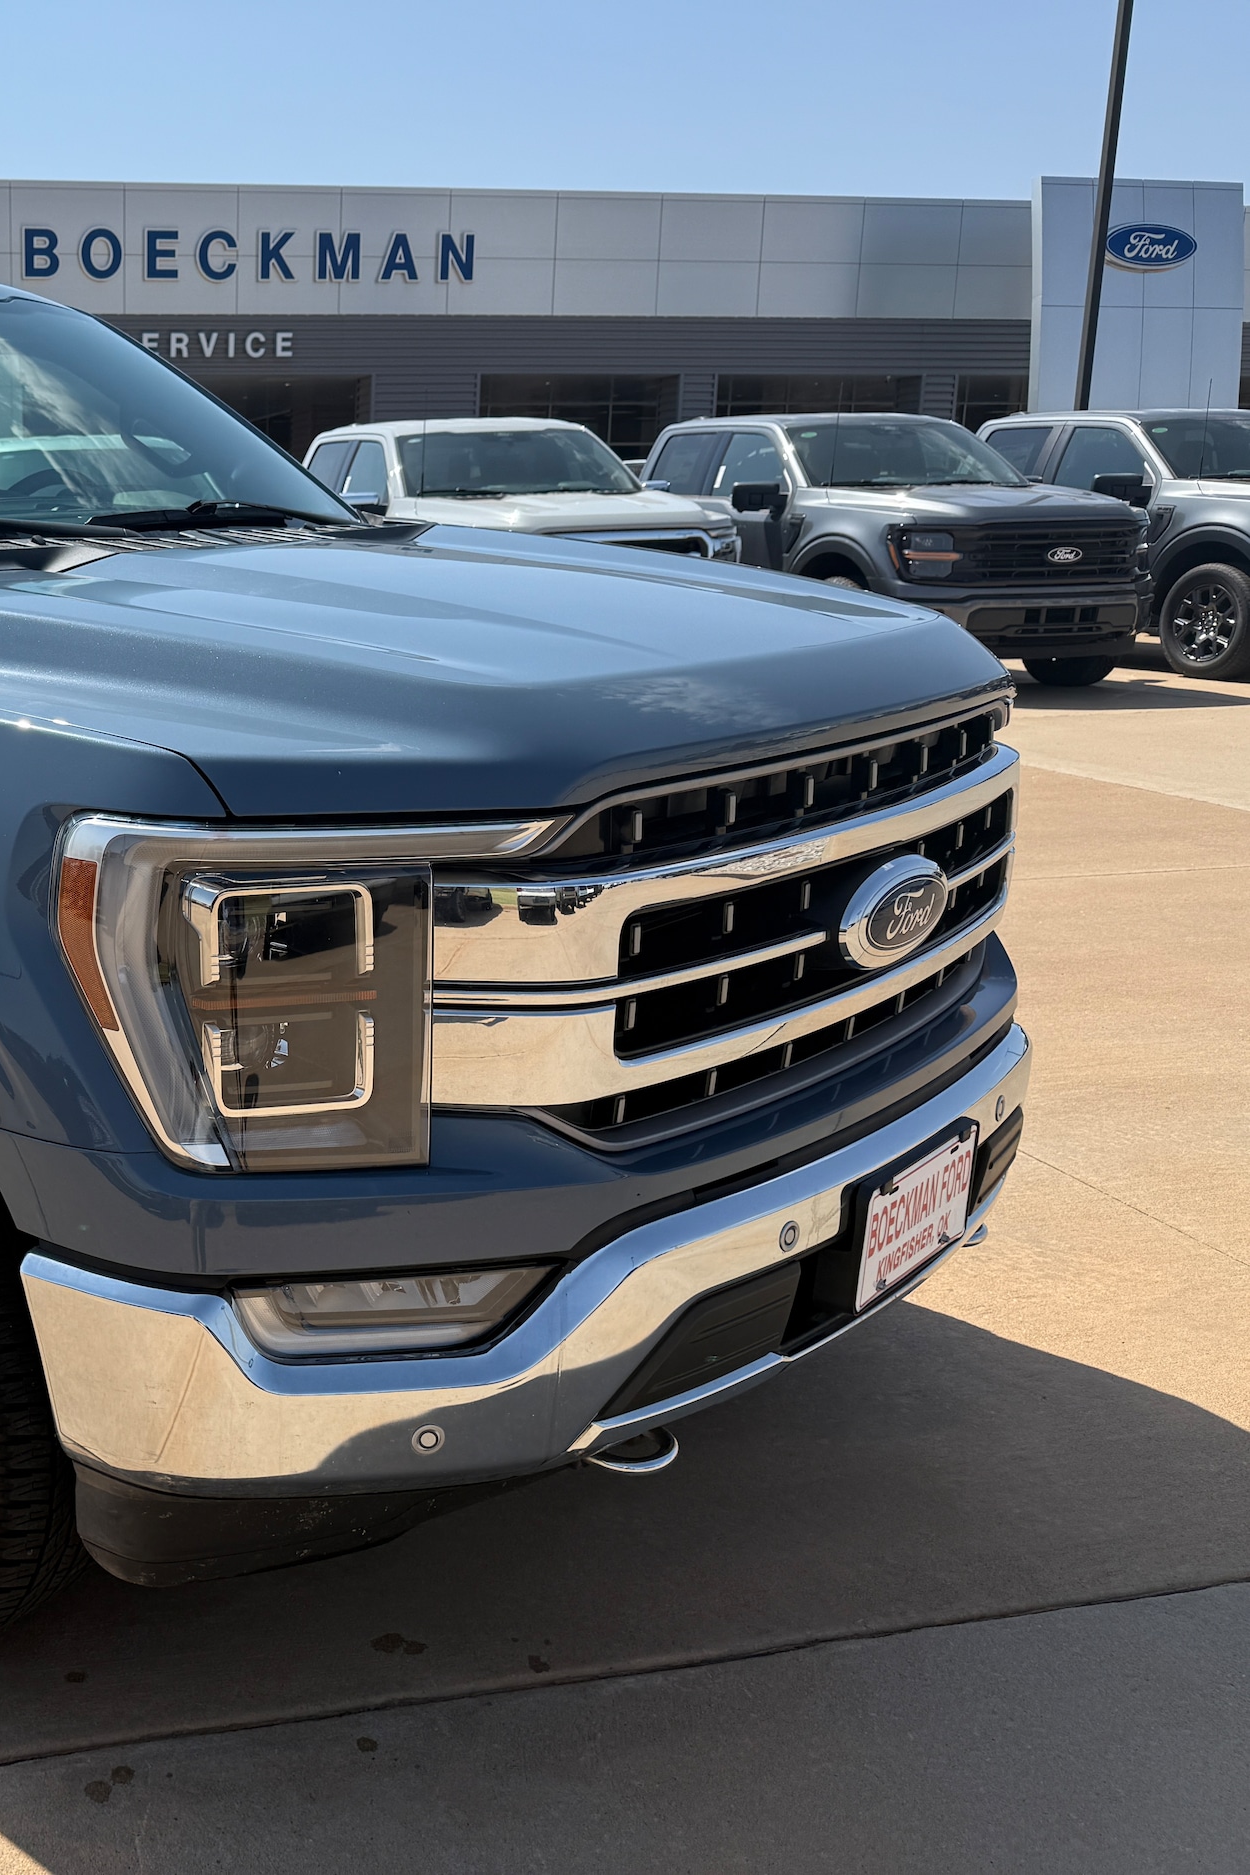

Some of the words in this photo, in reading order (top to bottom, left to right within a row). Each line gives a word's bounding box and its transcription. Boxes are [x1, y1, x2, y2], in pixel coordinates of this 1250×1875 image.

[22, 226, 476, 283] BOECKMAN
[1124, 231, 1179, 258] Ford
[141, 331, 294, 359] ERVICE
[886, 887, 936, 940] Ford
[867, 1172, 940, 1258] BOECKMAN
[938, 1150, 971, 1208] FORD
[876, 1223, 935, 1280] KINGFISHER,
[937, 1210, 952, 1237] OK
